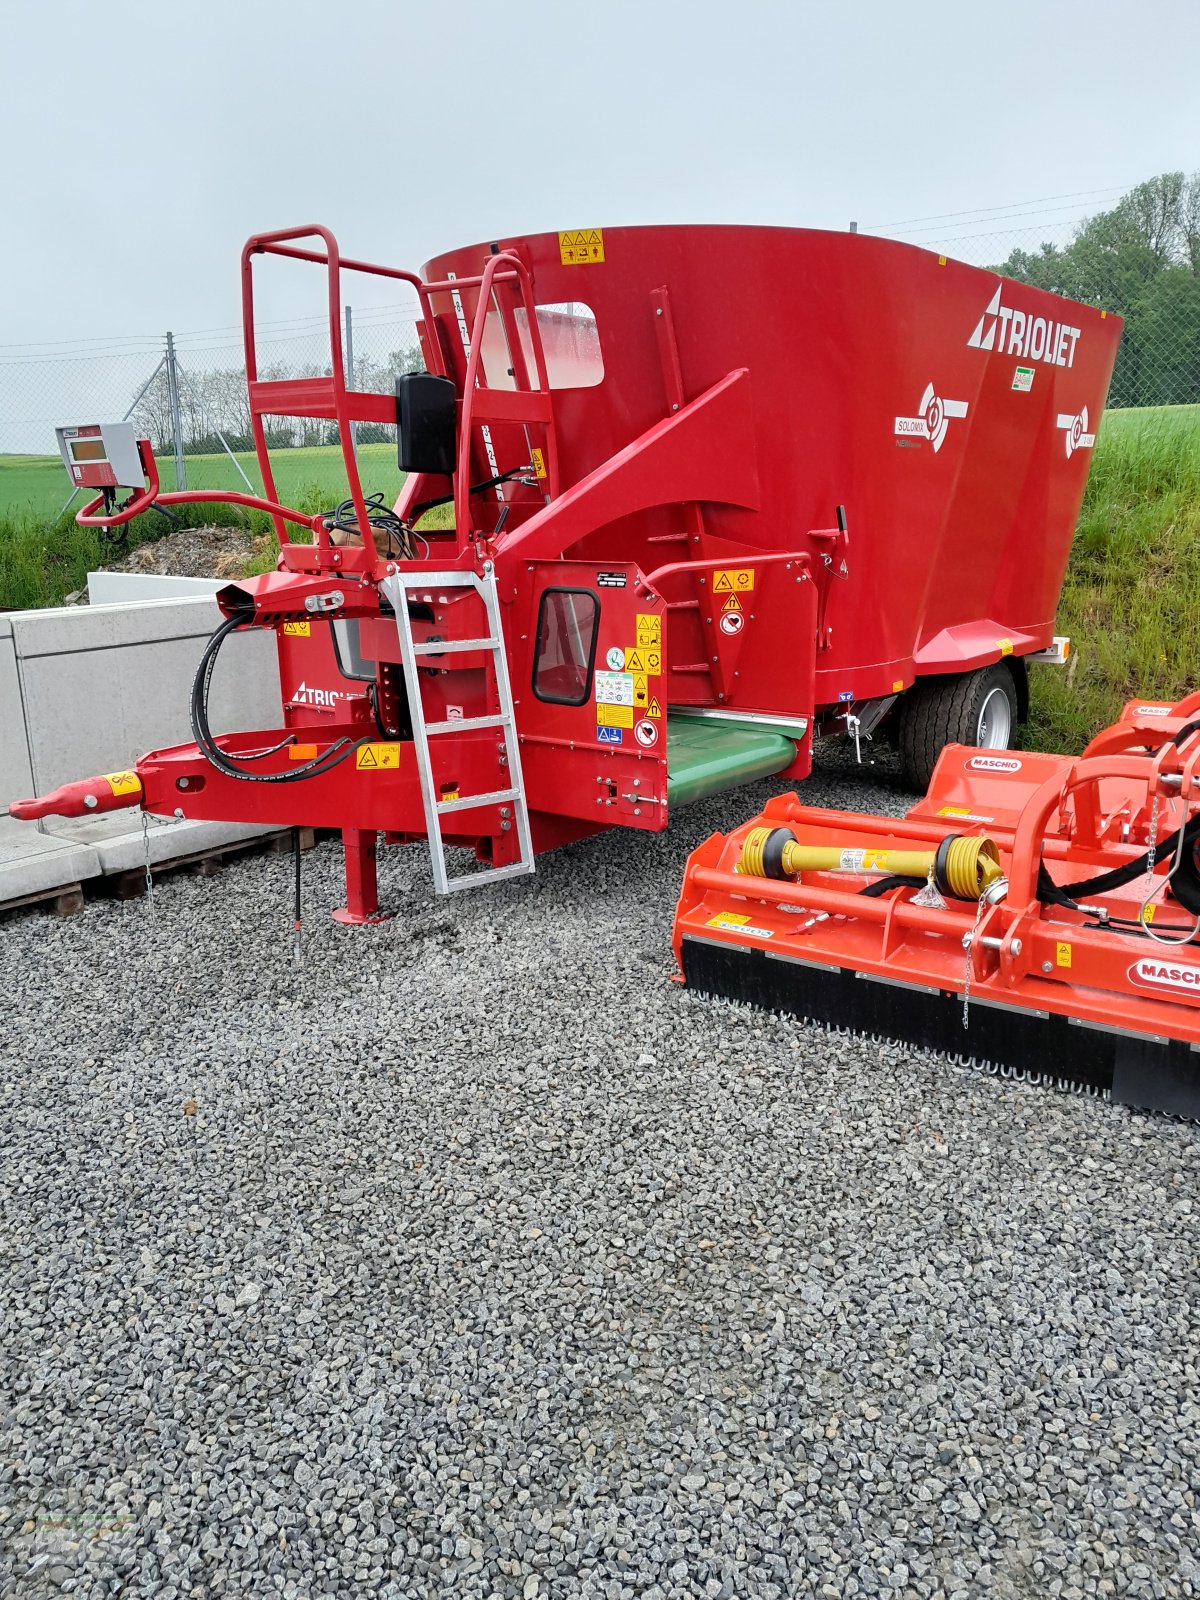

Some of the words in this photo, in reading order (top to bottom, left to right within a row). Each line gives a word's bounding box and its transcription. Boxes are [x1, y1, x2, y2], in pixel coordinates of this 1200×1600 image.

[998, 306, 1081, 368] TRIOLIET
[898, 420, 924, 433] SOLOMIX
[973, 759, 1018, 770] MASCHIO
